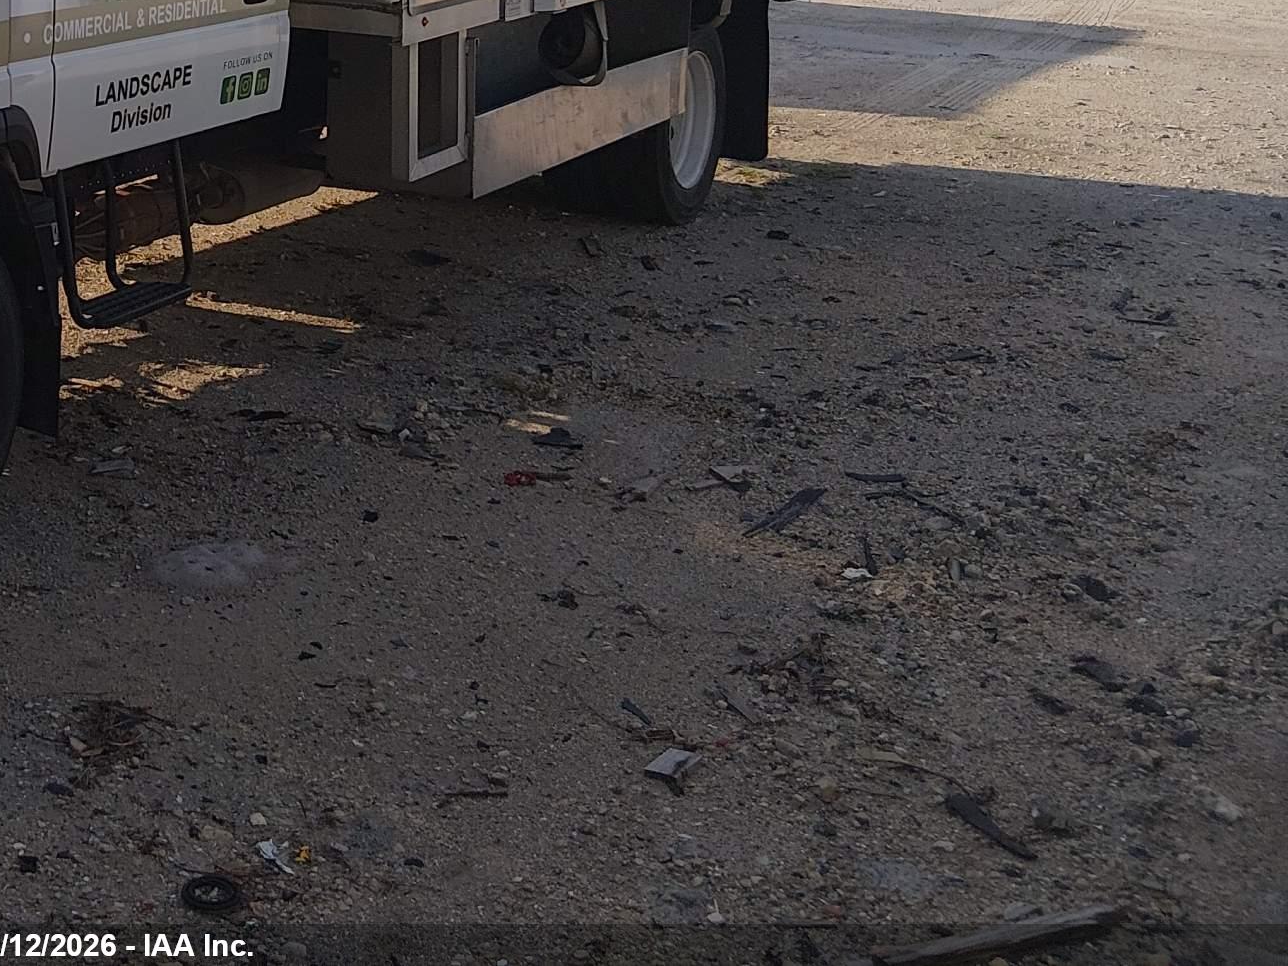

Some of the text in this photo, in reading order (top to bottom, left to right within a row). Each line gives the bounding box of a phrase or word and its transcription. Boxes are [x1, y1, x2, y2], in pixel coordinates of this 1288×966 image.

[43, 11, 132, 44] COMMERCIAL
[136, 8, 145, 28] &
[223, 56, 251, 70] FOLLOW
[253, 53, 262, 63] US
[95, 64, 193, 107] LANDSCAPE
[111, 101, 171, 133] Division
